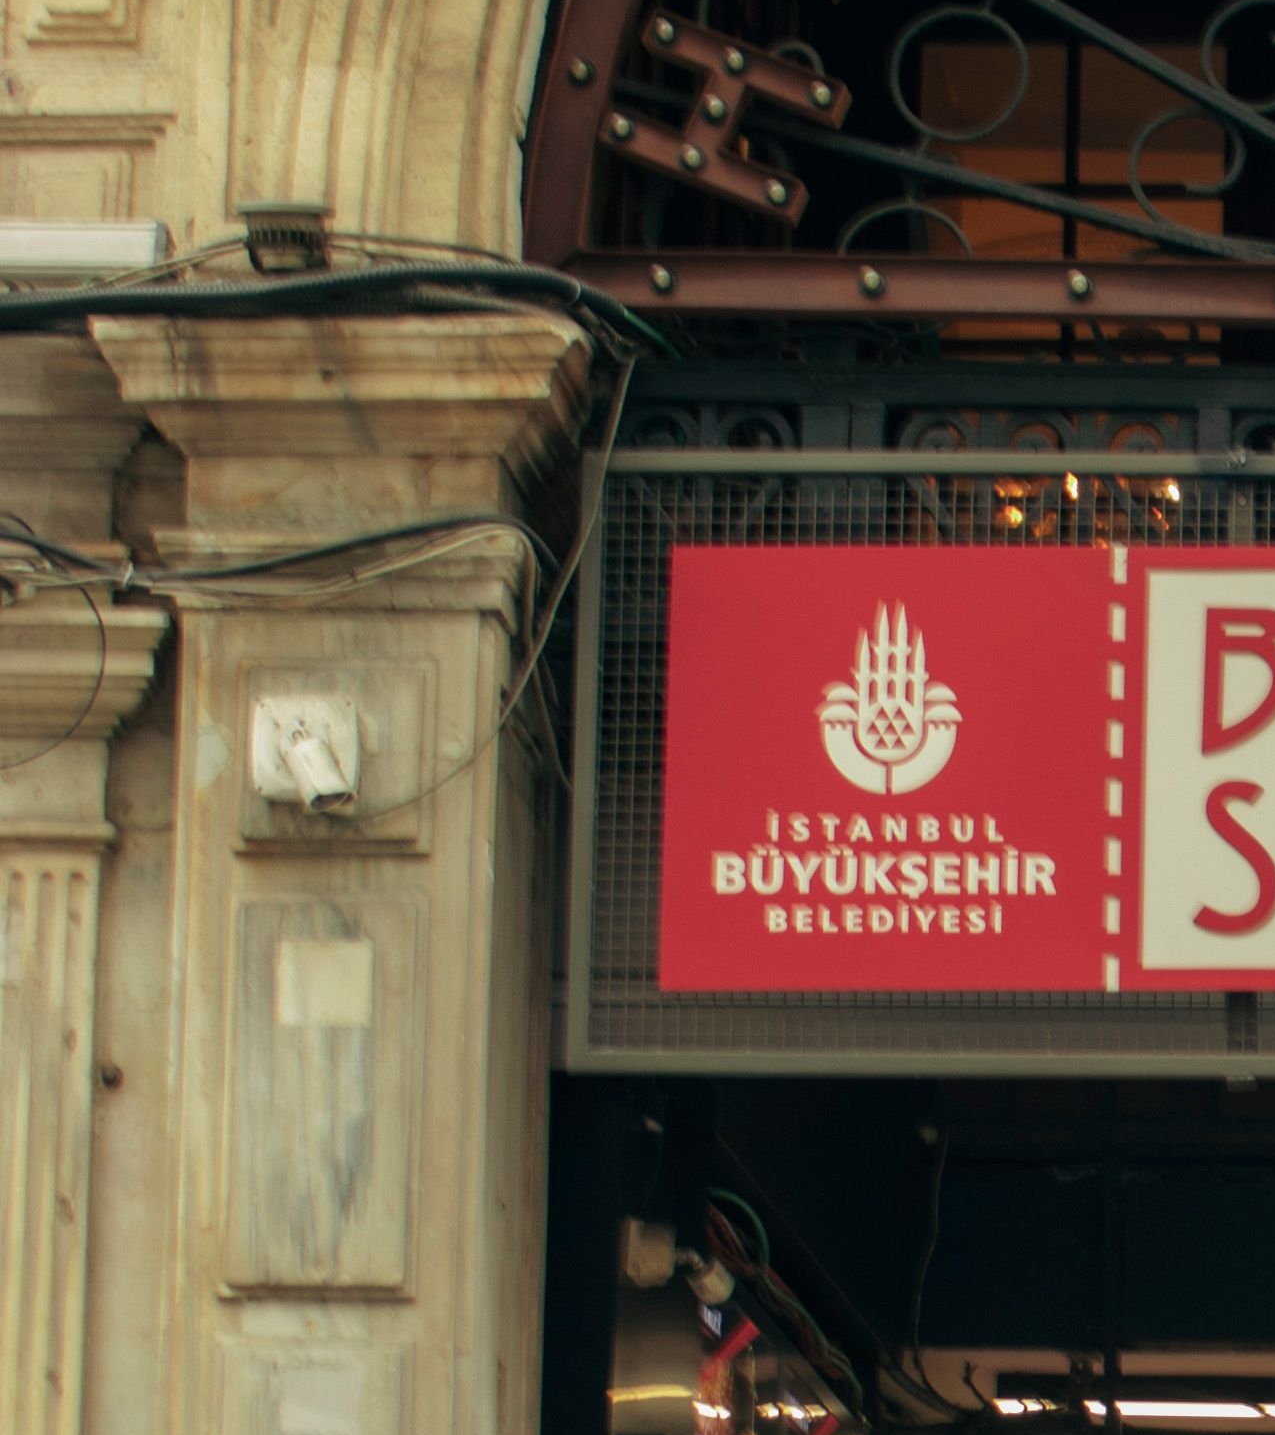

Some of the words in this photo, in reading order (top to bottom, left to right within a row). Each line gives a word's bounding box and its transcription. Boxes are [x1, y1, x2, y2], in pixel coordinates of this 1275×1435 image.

[765, 807, 1006, 844] İSTANBUL
[710, 843, 1058, 899] BÜYÜKŞEHİR
[763, 899, 1005, 935] BELEDİYESİ
